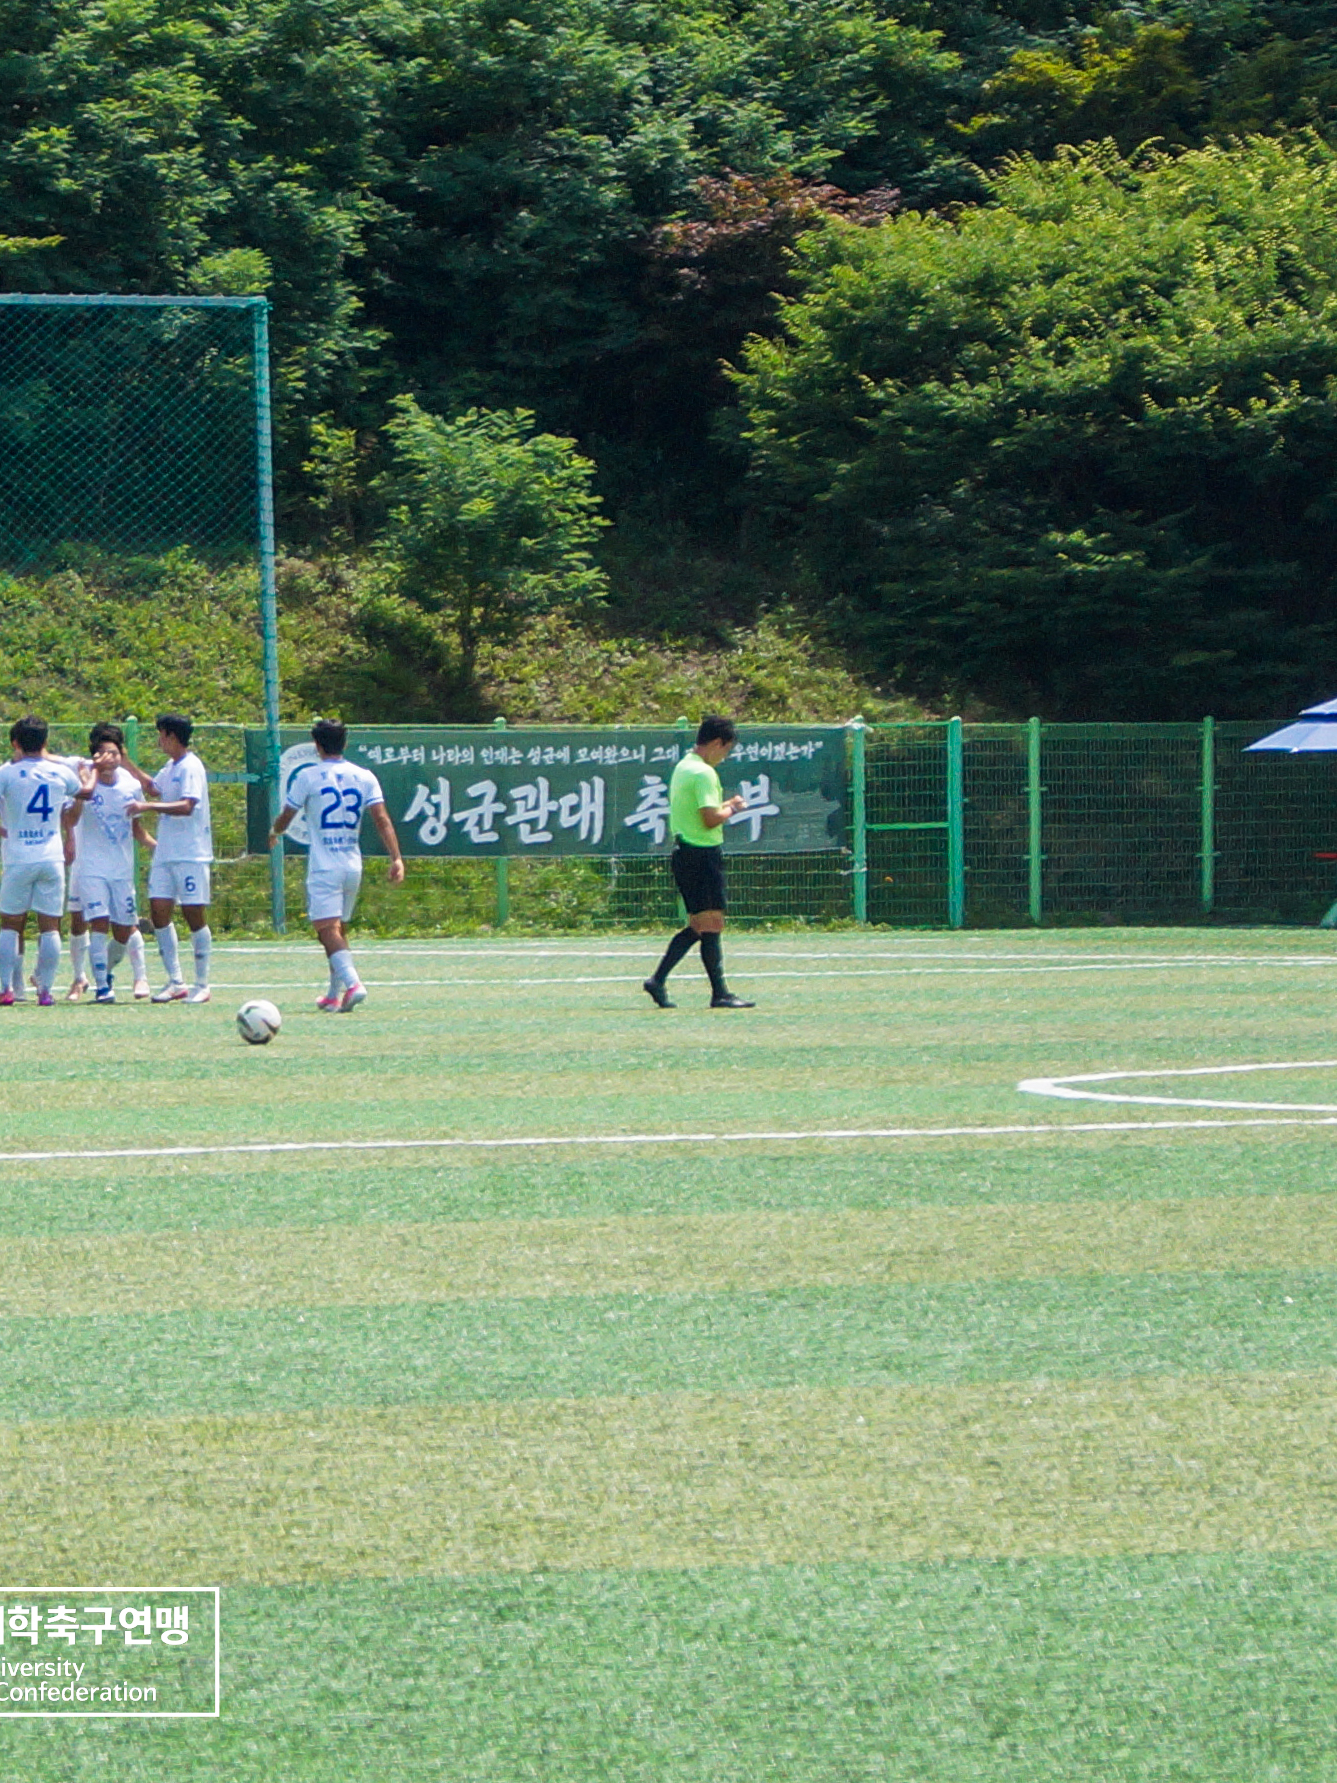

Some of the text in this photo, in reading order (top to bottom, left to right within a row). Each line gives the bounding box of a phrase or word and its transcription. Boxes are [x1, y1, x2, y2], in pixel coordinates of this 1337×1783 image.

[431, 744, 475, 766] 나라의
[527, 745, 571, 766] 성균에
[649, 743, 680, 763] 그대
[26, 784, 54, 823] 4
[320, 786, 362, 830] 23
[402, 773, 780, 845] 성균관대 축부
[184, 876, 196, 892] 6
